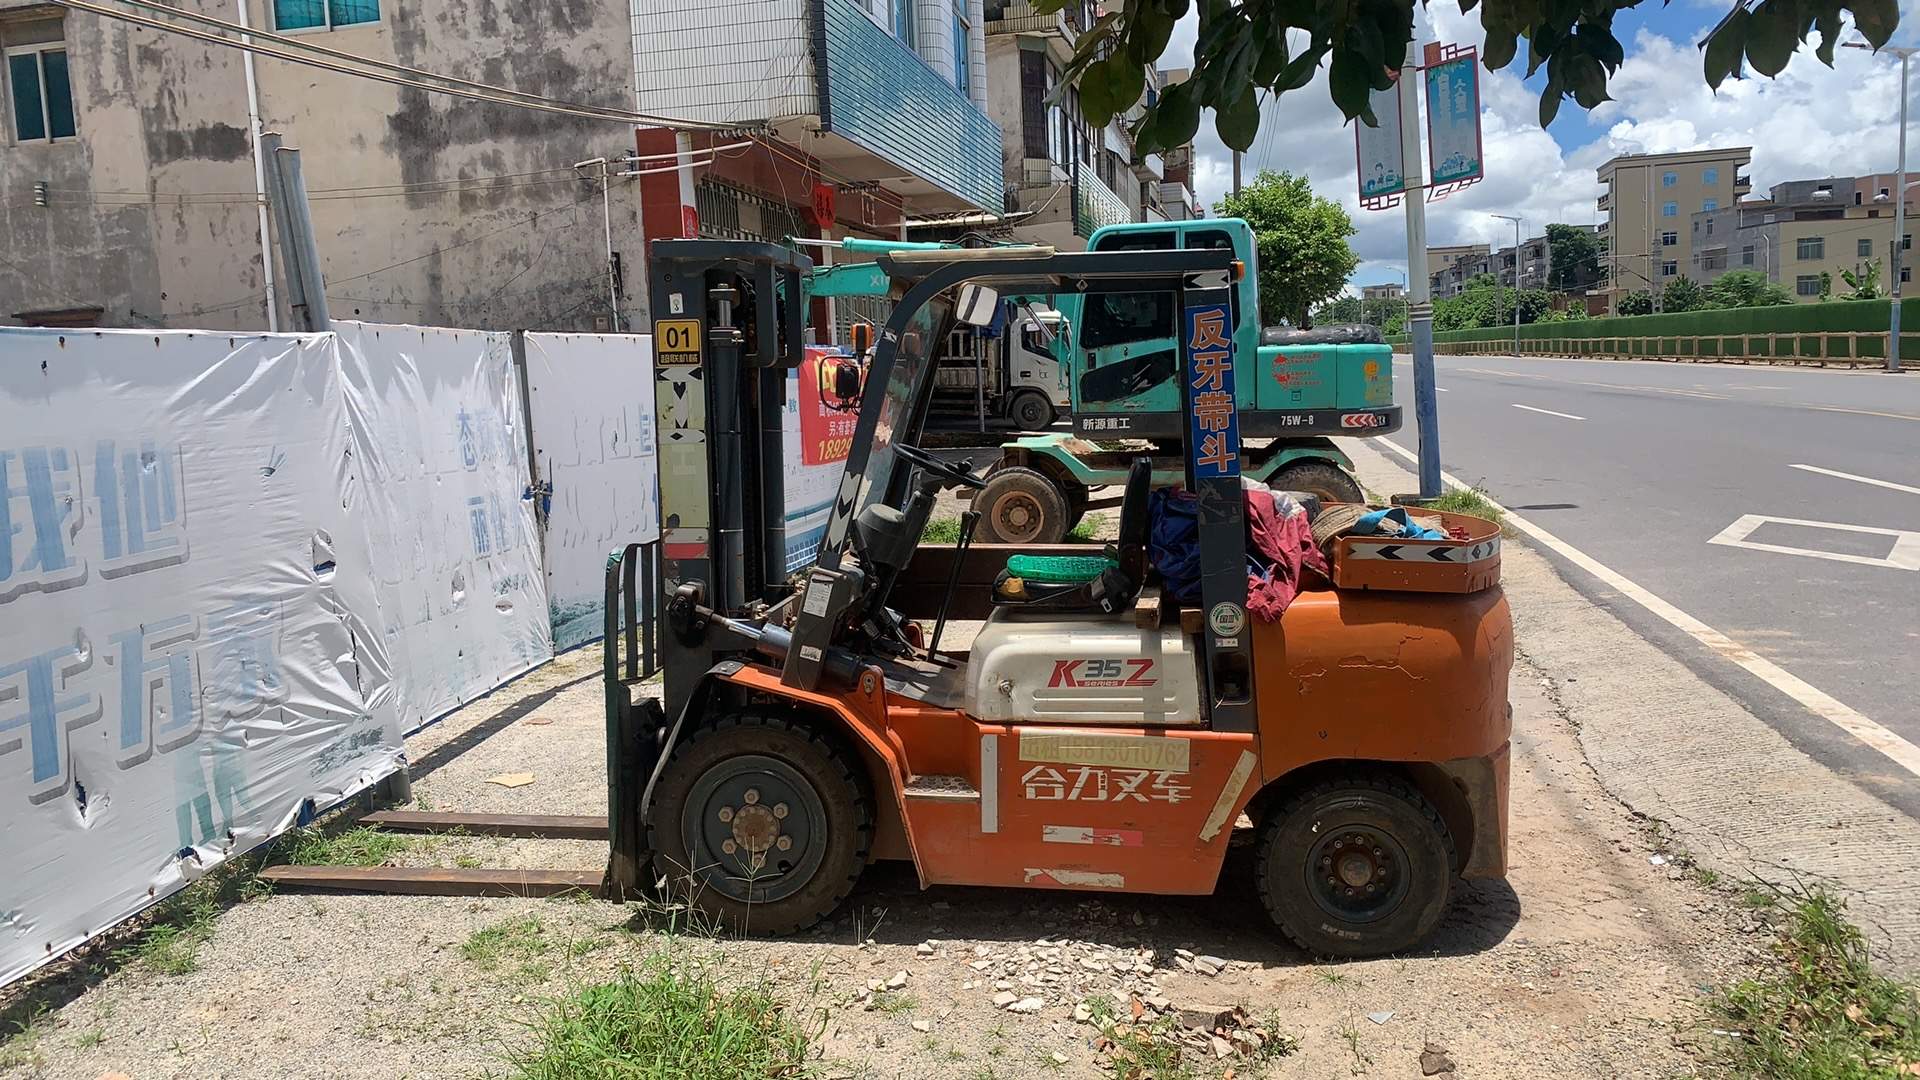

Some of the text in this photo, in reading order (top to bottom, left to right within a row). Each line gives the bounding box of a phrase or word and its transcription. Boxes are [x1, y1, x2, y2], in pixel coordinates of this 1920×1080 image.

[666, 327, 690, 348] 01
[1190, 308, 1237, 474] 反牙带斗
[1082, 417, 1131, 430] 新源重工
[1021, 766, 1192, 803] 合力叉车
